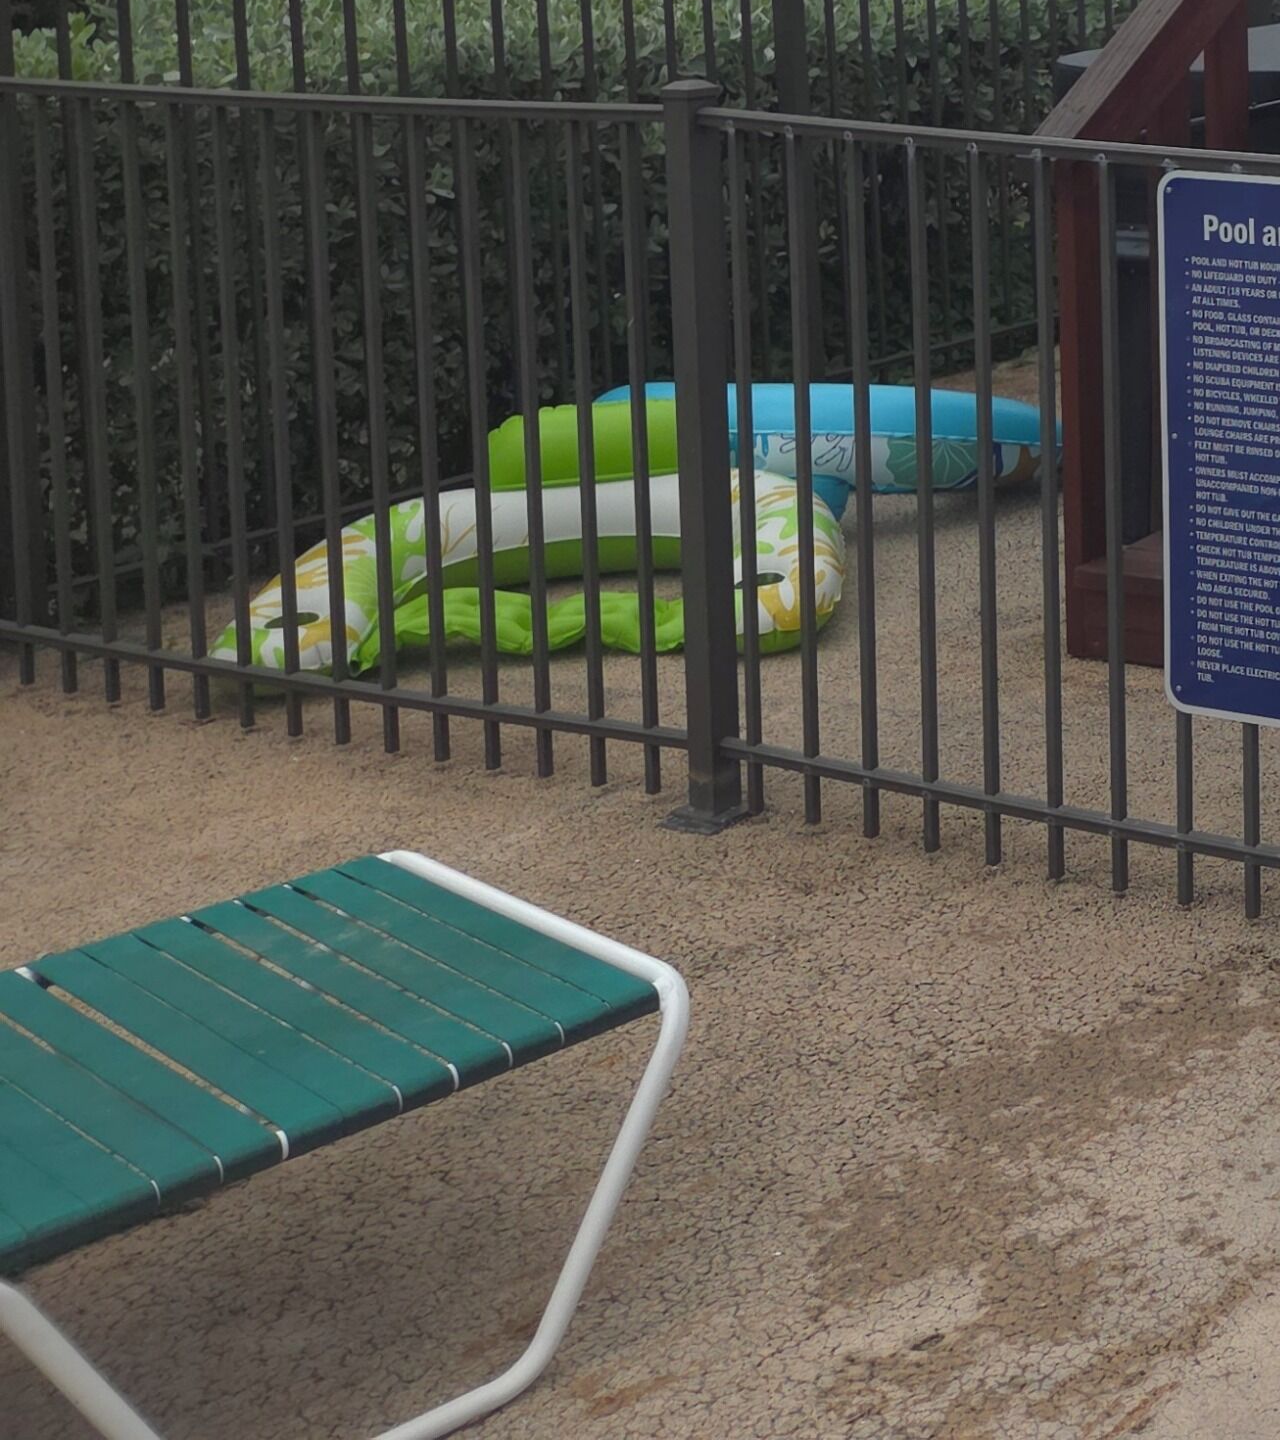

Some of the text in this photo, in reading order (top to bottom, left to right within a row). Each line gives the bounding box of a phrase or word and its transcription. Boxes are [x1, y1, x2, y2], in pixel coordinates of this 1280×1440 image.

[1204, 214, 1255, 245] Pool
[1190, 256, 1210, 266] POOL
[1211, 258, 1226, 267] AND
[1228, 259, 1242, 268] HOT
[1244, 260, 1258, 270] TUB
[1191, 269, 1202, 278] NO
[1203, 270, 1243, 282] LIFEGUARD
[1244, 274, 1255, 283] ON
[1257, 275, 1277, 285] DUTY
[1191, 283, 1202, 292] AN
[1203, 284, 1225, 294] ADULT
[1241, 287, 1265, 298] YEARS
[1266, 290, 1277, 299] OR
[1192, 295, 1200, 304] AT
[1202, 296, 1214, 305] ALL
[1191, 309, 1202, 318] NO
[1226, 312, 1251, 323] GLASS
[1215, 323, 1230, 333] HOT
[1249, 326, 1260, 335] OR
[1261, 327, 1280, 337] DECK
[1192, 335, 1203, 344] NO
[1204, 336, 1261, 350] BROADCASTING
[1262, 341, 1271, 351] OF
[1193, 347, 1230, 359] LISTENING
[1231, 351, 1263, 362] DEVICES
[1264, 354, 1278, 363] ARE
[1192, 360, 1203, 369] NO
[1204, 361, 1240, 373] DIAPERED
[1242, 365, 1279, 377] CHILDREN
[1195, 504, 1206, 513] DO
[1207, 505, 1221, 515] NOT
[1222, 507, 1239, 517] GIVE
[1240, 509, 1255, 519] OUT
[1256, 511, 1270, 521] THE
[1196, 581, 1212, 592] AND
[1213, 584, 1232, 594] AREA
[1196, 595, 1206, 605] DO
[1208, 597, 1222, 607] NOT
[1223, 599, 1238, 609] USE
[1239, 601, 1253, 611] THE
[1254, 603, 1273, 614] POOL
[1196, 634, 1207, 643] DO
[1208, 636, 1222, 646] NOT
[1223, 638, 1238, 648] USE
[1240, 640, 1253, 650] THE
[1254, 642, 1269, 653] HOT
[1196, 659, 1220, 671] NEVER
[1221, 663, 1244, 675] PLACE
